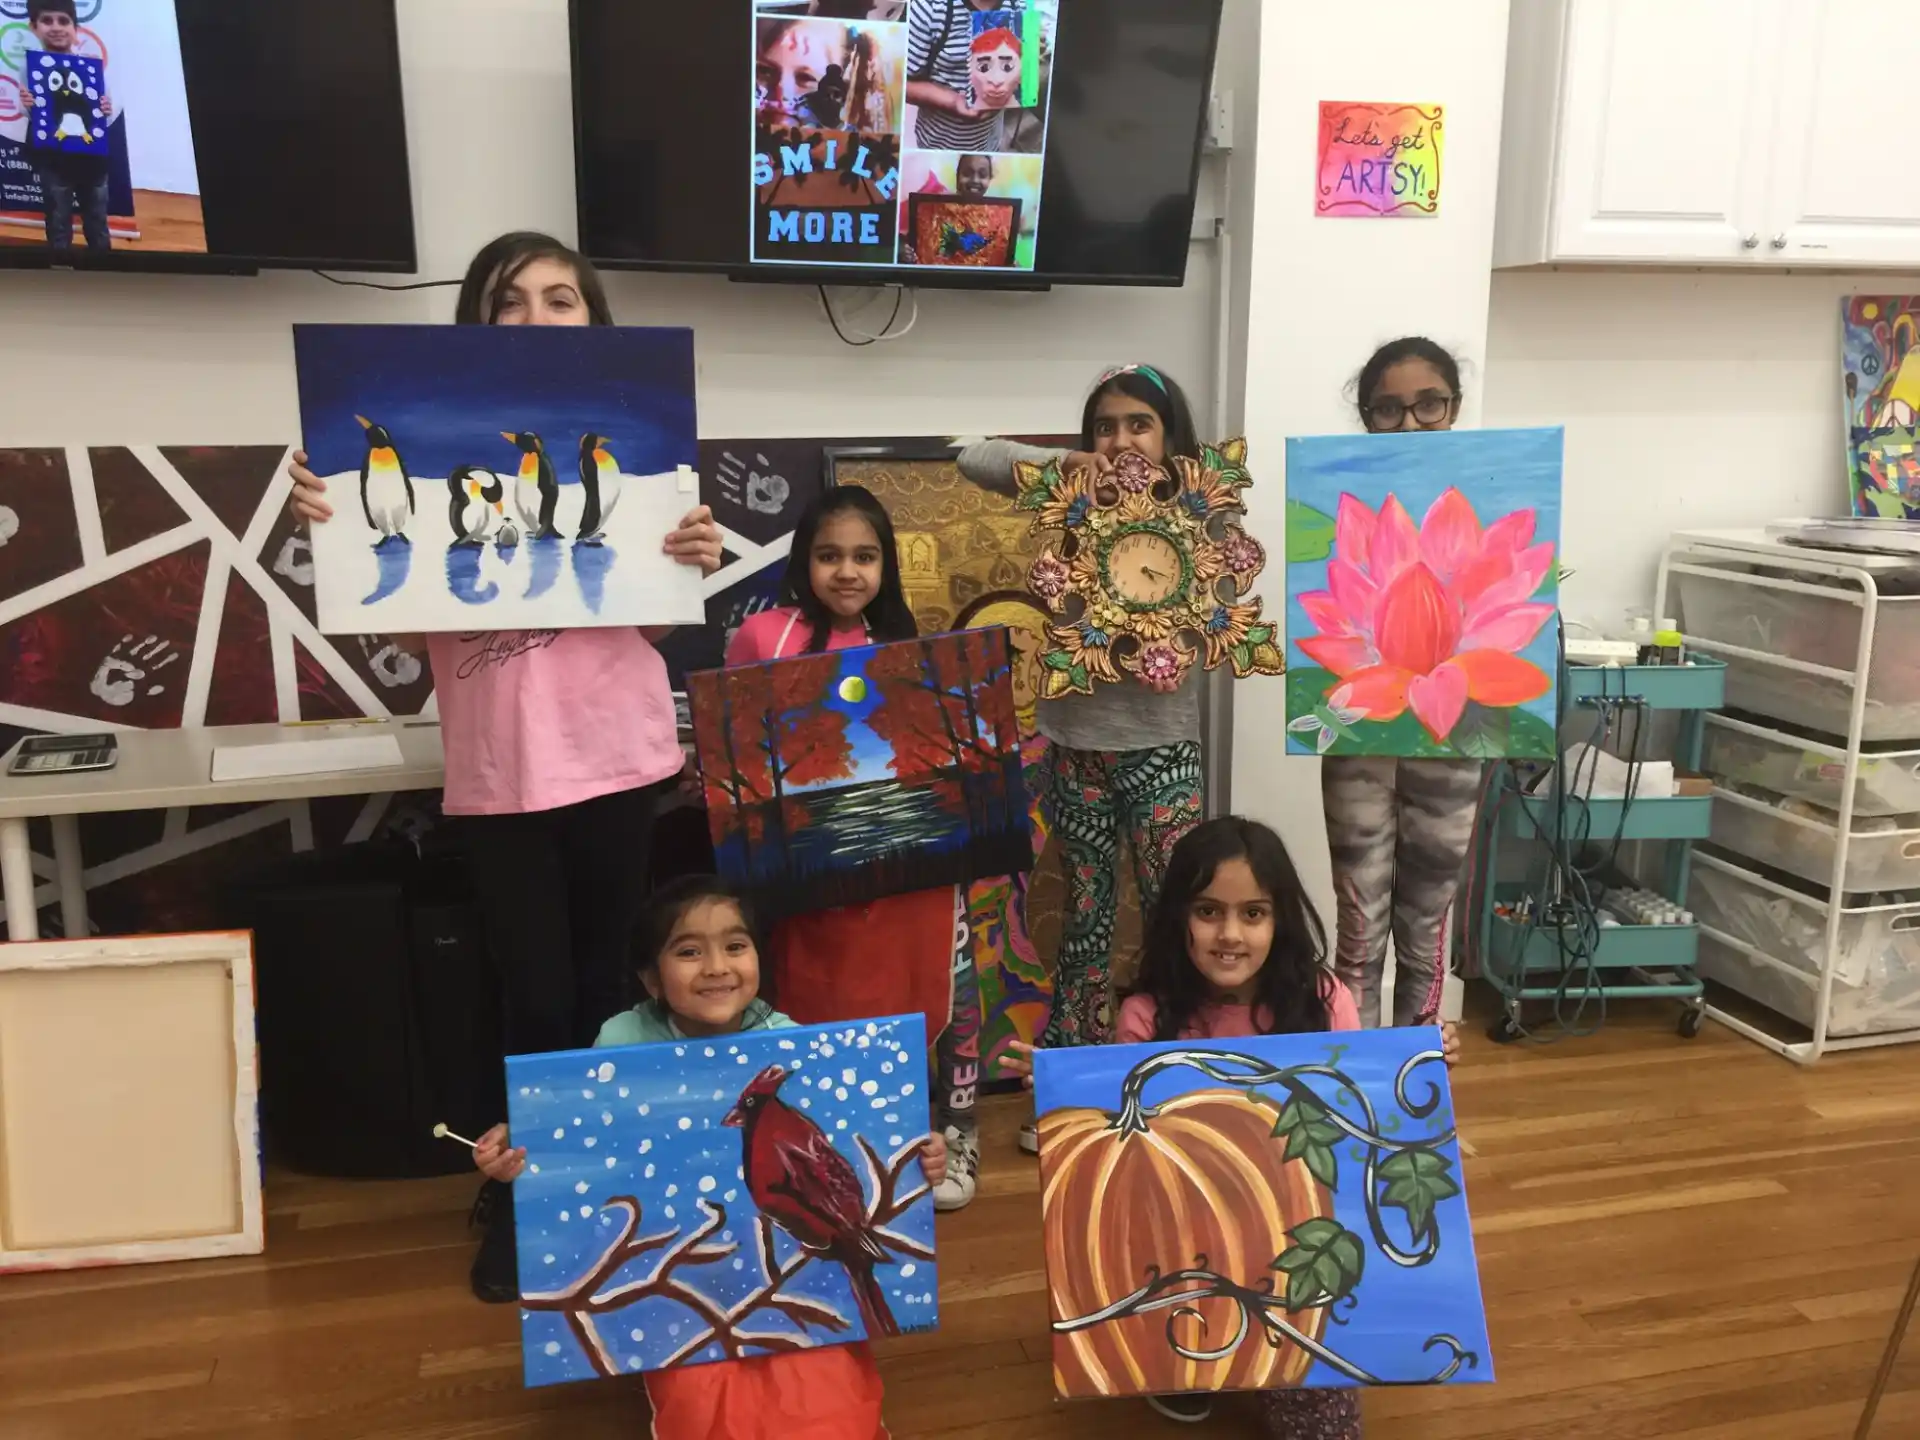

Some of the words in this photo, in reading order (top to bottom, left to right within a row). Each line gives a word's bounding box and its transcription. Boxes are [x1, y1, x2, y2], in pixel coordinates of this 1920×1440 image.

[1333, 116, 1383, 146] Let's
[1384, 126, 1425, 159] get
[754, 140, 899, 200] SMILE
[1336, 158, 1426, 197] ARTSY!
[768, 209, 880, 244] MORE
[1147, 536, 1157, 550] 12
